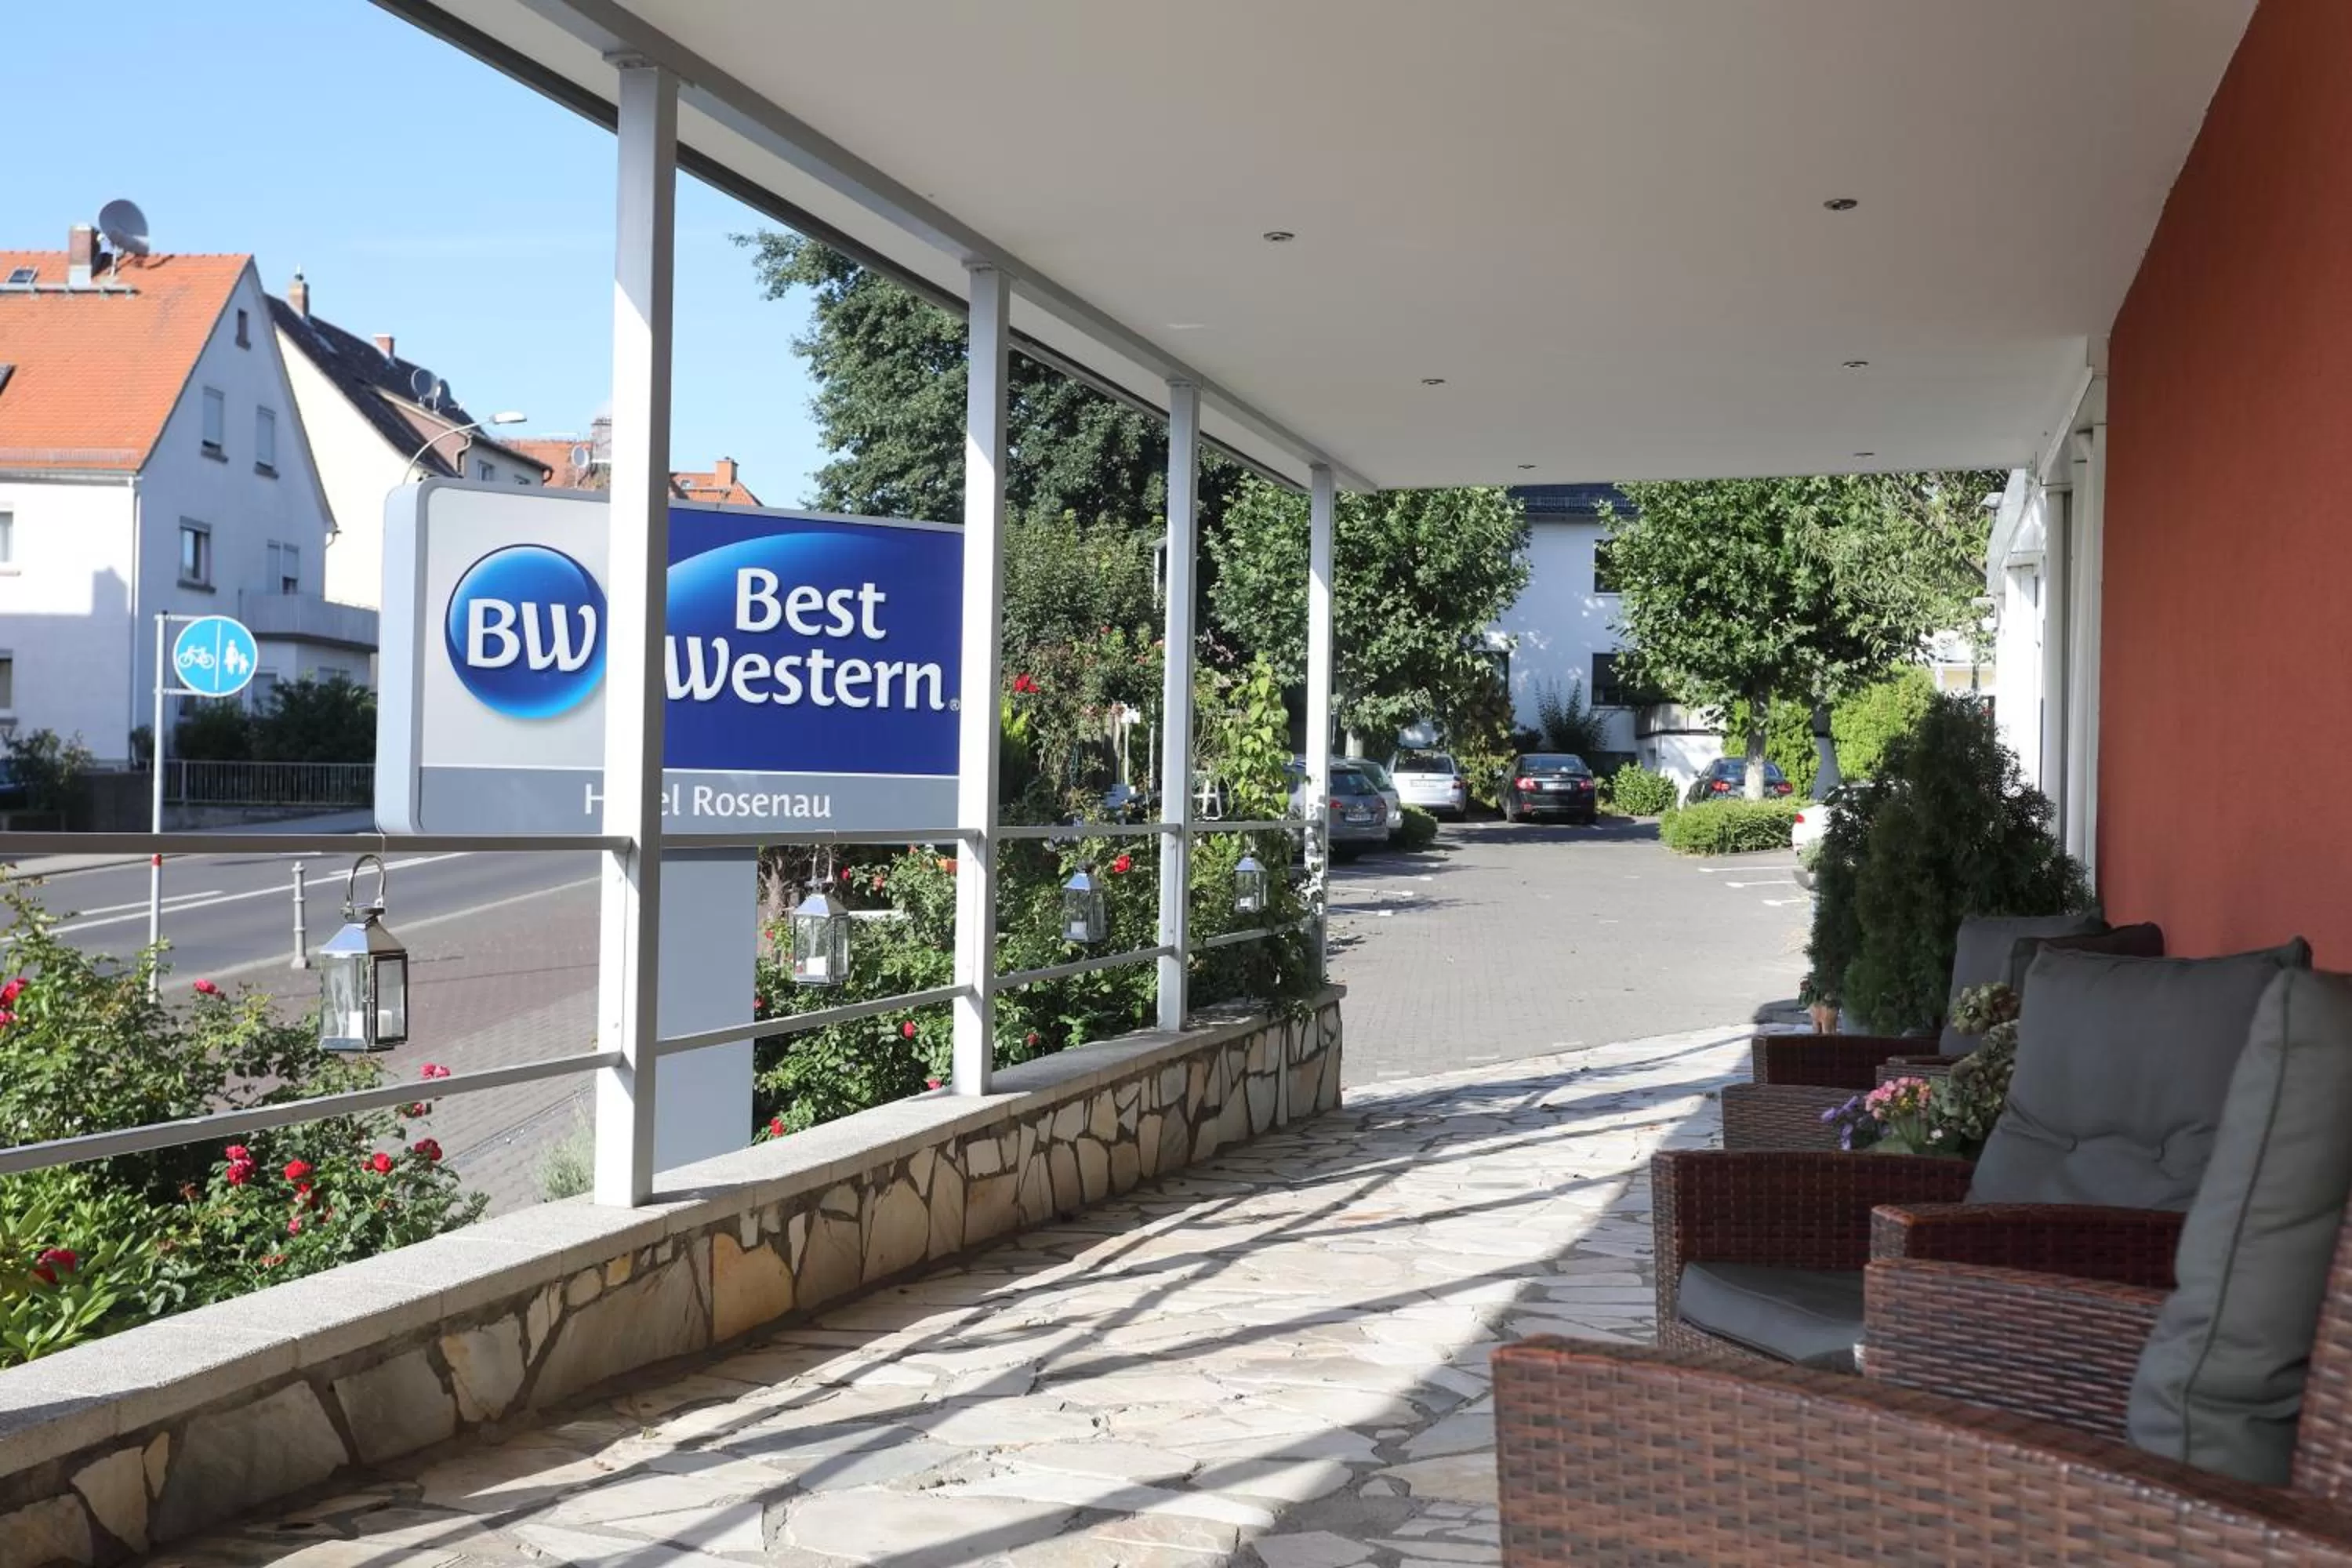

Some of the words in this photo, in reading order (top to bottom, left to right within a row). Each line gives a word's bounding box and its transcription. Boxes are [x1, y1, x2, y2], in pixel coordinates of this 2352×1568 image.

[467, 598, 597, 672] BW
[735, 567, 887, 640] Best
[693, 785, 833, 818] Rosenau
